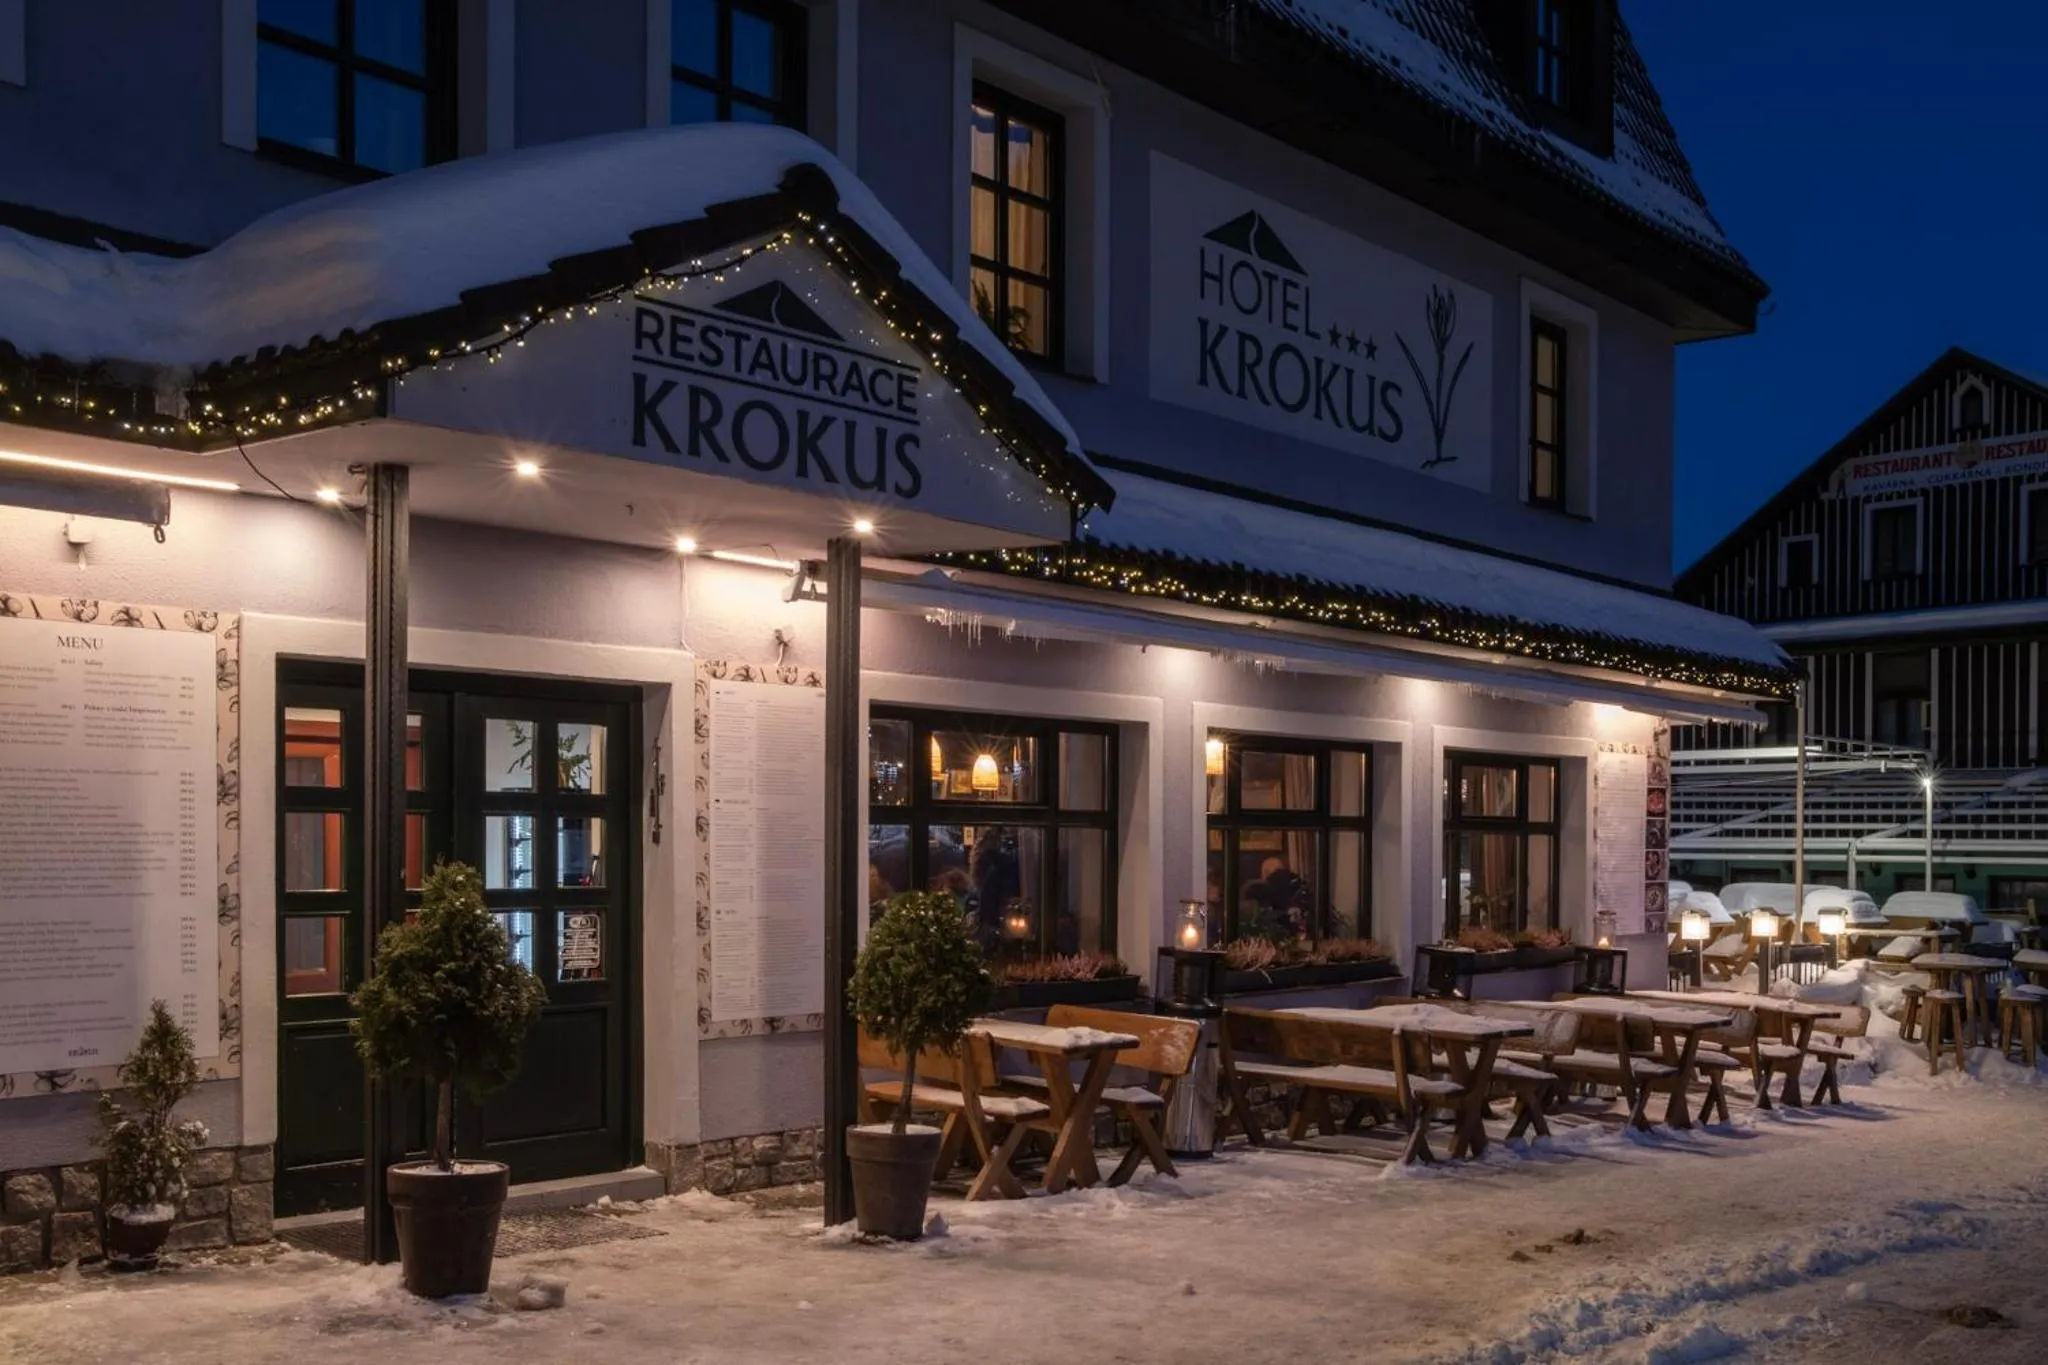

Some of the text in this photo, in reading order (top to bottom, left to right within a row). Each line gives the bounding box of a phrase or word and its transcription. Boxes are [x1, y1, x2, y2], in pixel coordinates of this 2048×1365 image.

[1200, 245, 1321, 340] HOTEL
[633, 306, 919, 415] RESTAURACE
[1197, 316, 1404, 443] KROKUS
[632, 371, 922, 499] KROKUS
[1854, 452, 1954, 478] RESTAURANT
[56, 635, 103, 651] MENU
